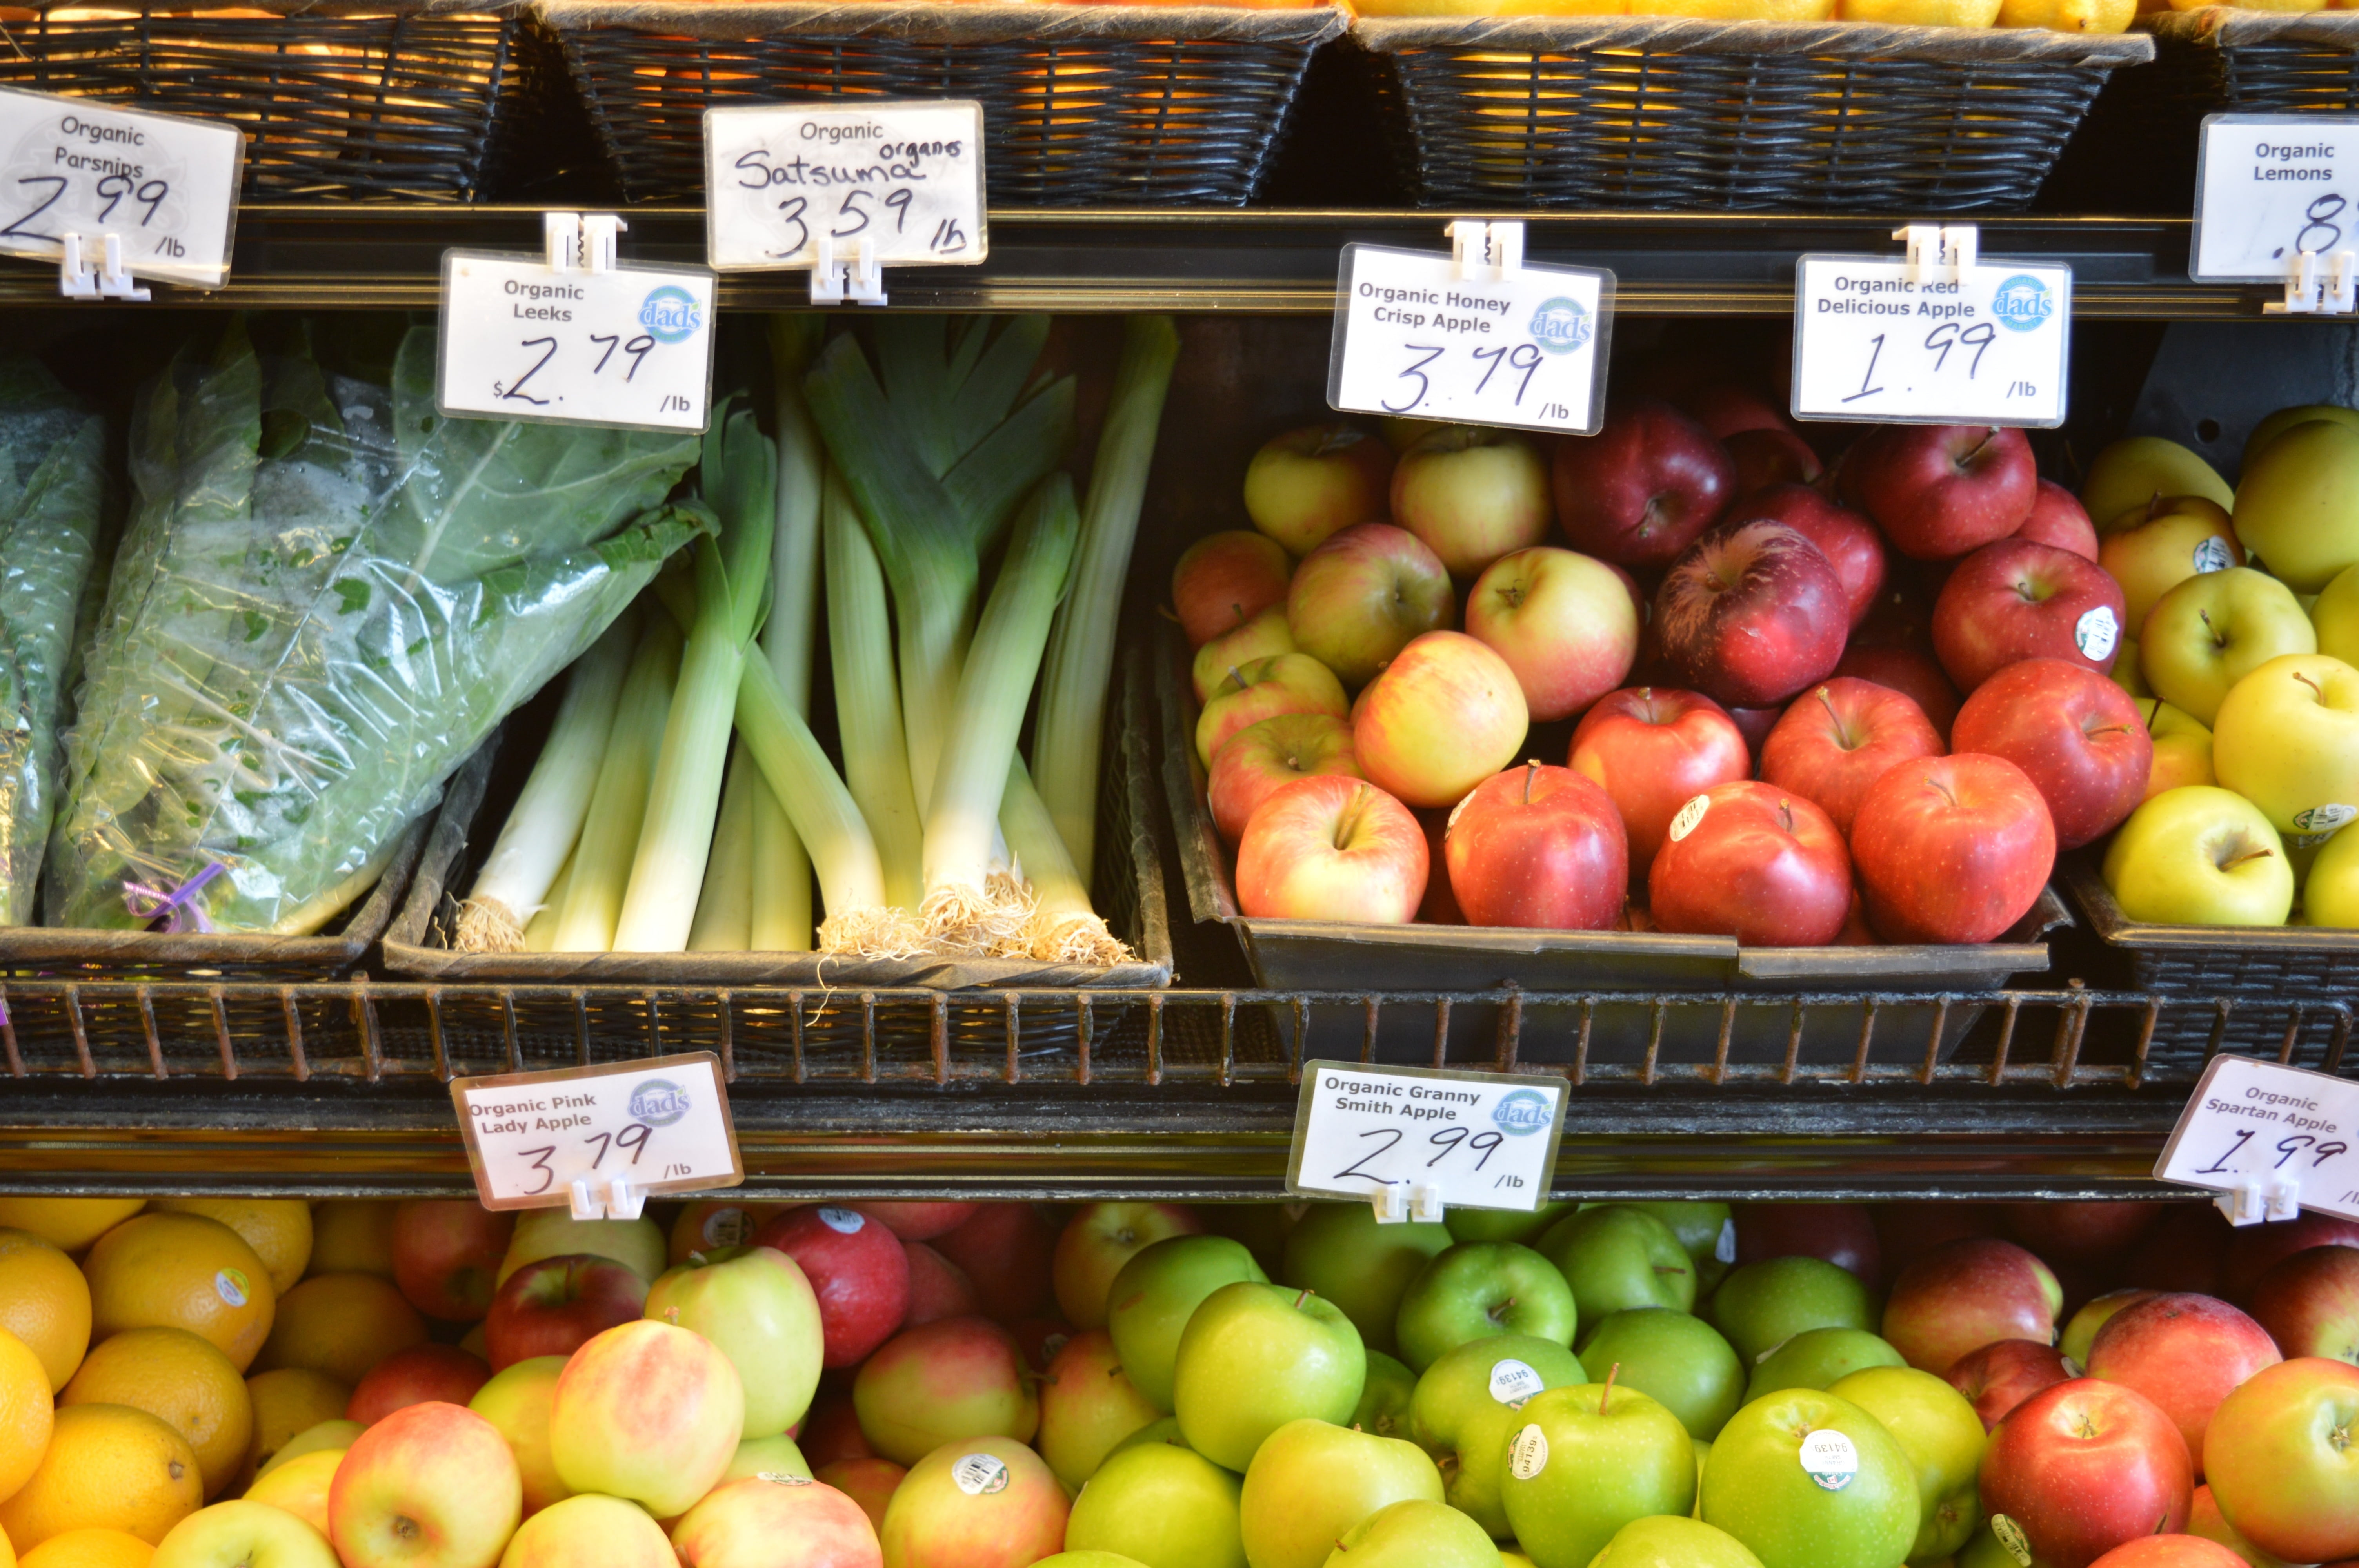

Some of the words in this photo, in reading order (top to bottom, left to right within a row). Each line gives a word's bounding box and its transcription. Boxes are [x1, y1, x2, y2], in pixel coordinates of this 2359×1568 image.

[61, 116, 144, 147] Organic
[800, 121, 883, 144] Organic
[2255, 143, 2335, 161] Organic
[55, 147, 143, 180] Parsnips
[735, 149, 926, 189] Satsuma
[2254, 166, 2332, 181] Lemons
[2272, 194, 2359, 259] .8
[155, 236, 185, 258] /lb
[504, 279, 584, 301] Organic
[1835, 276, 1914, 295] Organic
[2005, 278, 2041, 290] ORGANIC
[1359, 282, 1439, 305] Organic
[1446, 292, 1511, 315] Honey
[514, 303, 572, 322] Leeks
[1374, 306, 1425, 329] Crisp
[1432, 313, 1491, 334] Apple
[1818, 299, 1910, 316] Delicious
[1917, 302, 1975, 320] Apple
[2006, 319, 2037, 329] MARKET
[2006, 381, 2036, 399] /lb
[660, 395, 691, 412] /lb
[1538, 403, 1569, 420] /lb
[1325, 1076, 1403, 1097] Organic
[1409, 1086, 1481, 1106] Granny
[2245, 1087, 2318, 1111] Organic
[470, 1099, 546, 1117] Organic
[552, 1094, 597, 1109] Pink
[1335, 1097, 1393, 1114] Smith
[1399, 1105, 1457, 1121] Apple
[2206, 1099, 2278, 1120] Spartan
[2283, 1113, 2337, 1133] Apple
[482, 1120, 527, 1134] Lady
[536, 1114, 592, 1131] Apple
[663, 1164, 692, 1179] /lb
[1494, 1175, 1524, 1189] /lb
[2338, 1191, 2359, 1204] /l
